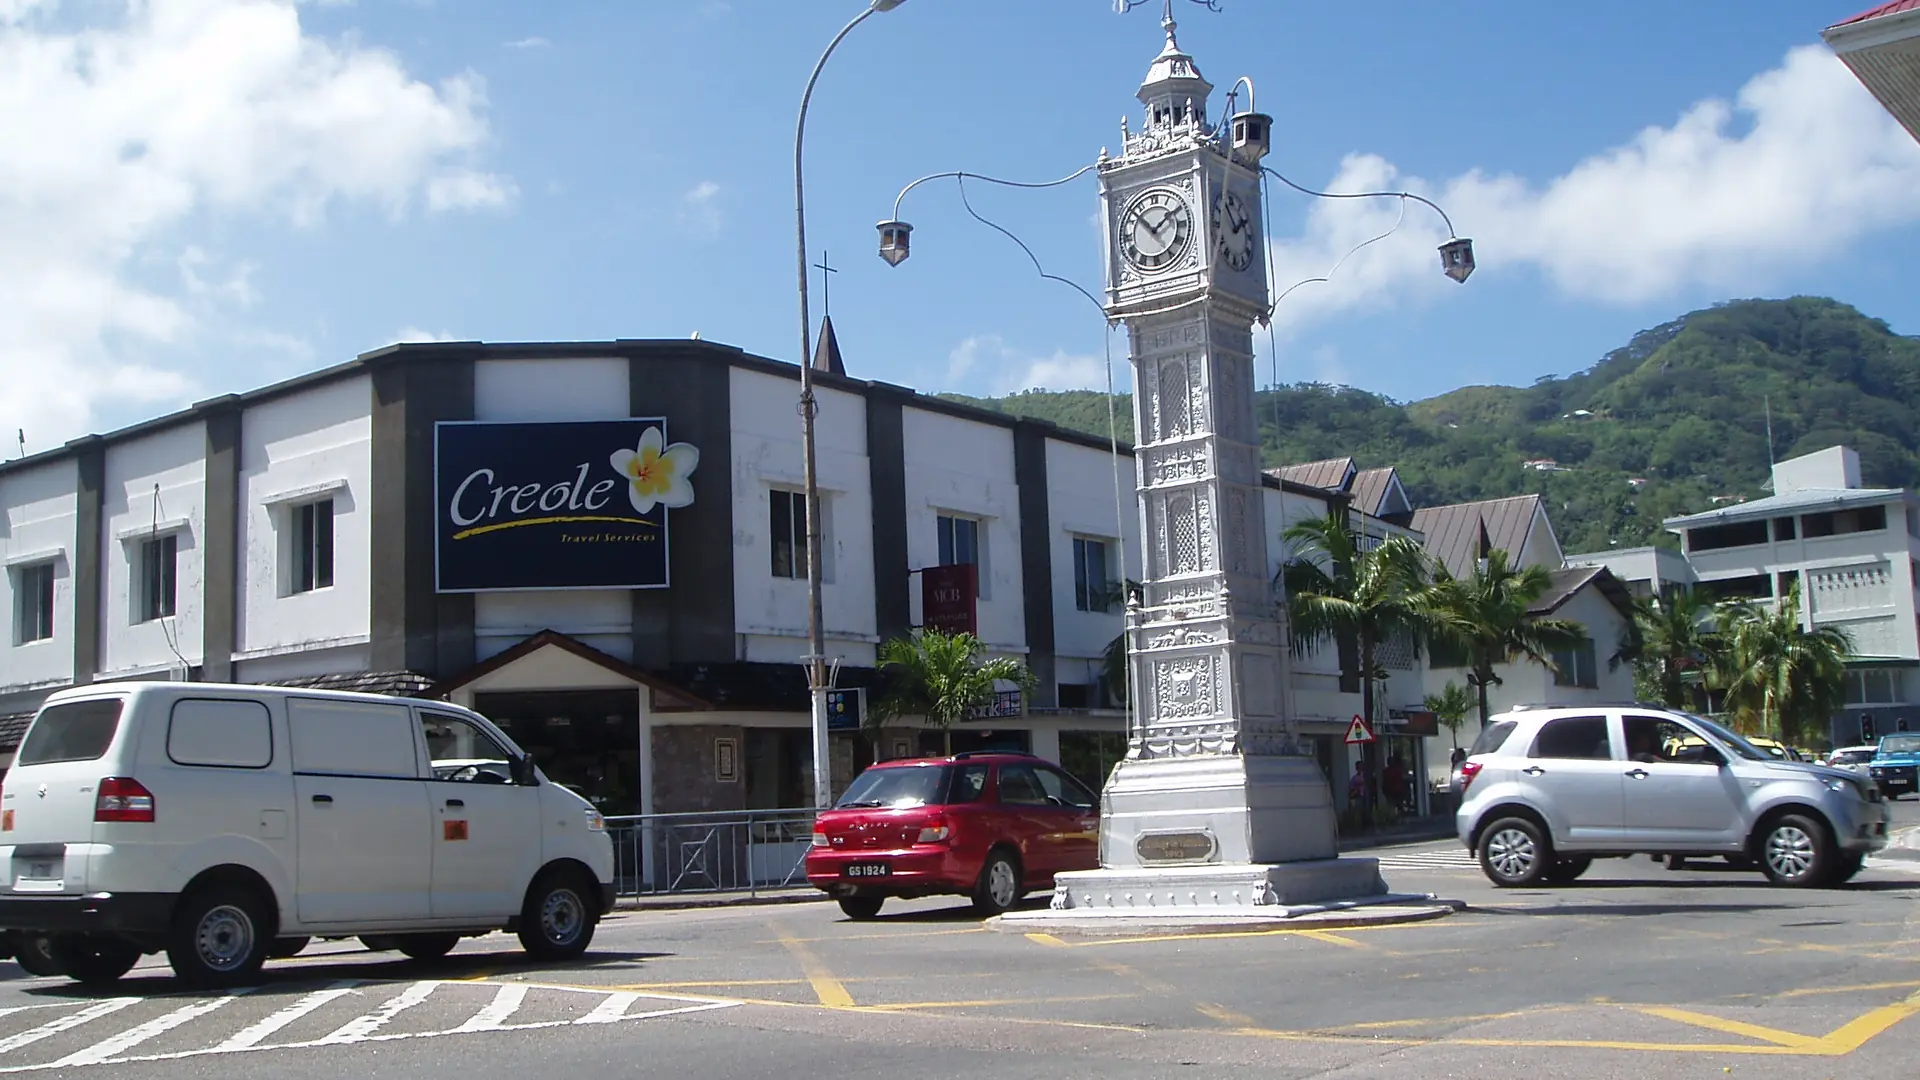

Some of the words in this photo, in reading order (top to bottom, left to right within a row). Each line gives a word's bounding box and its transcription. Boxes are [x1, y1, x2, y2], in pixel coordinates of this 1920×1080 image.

[450, 462, 615, 526] Creole
[561, 533, 600, 543] Travel
[604, 532, 656, 542] Services
